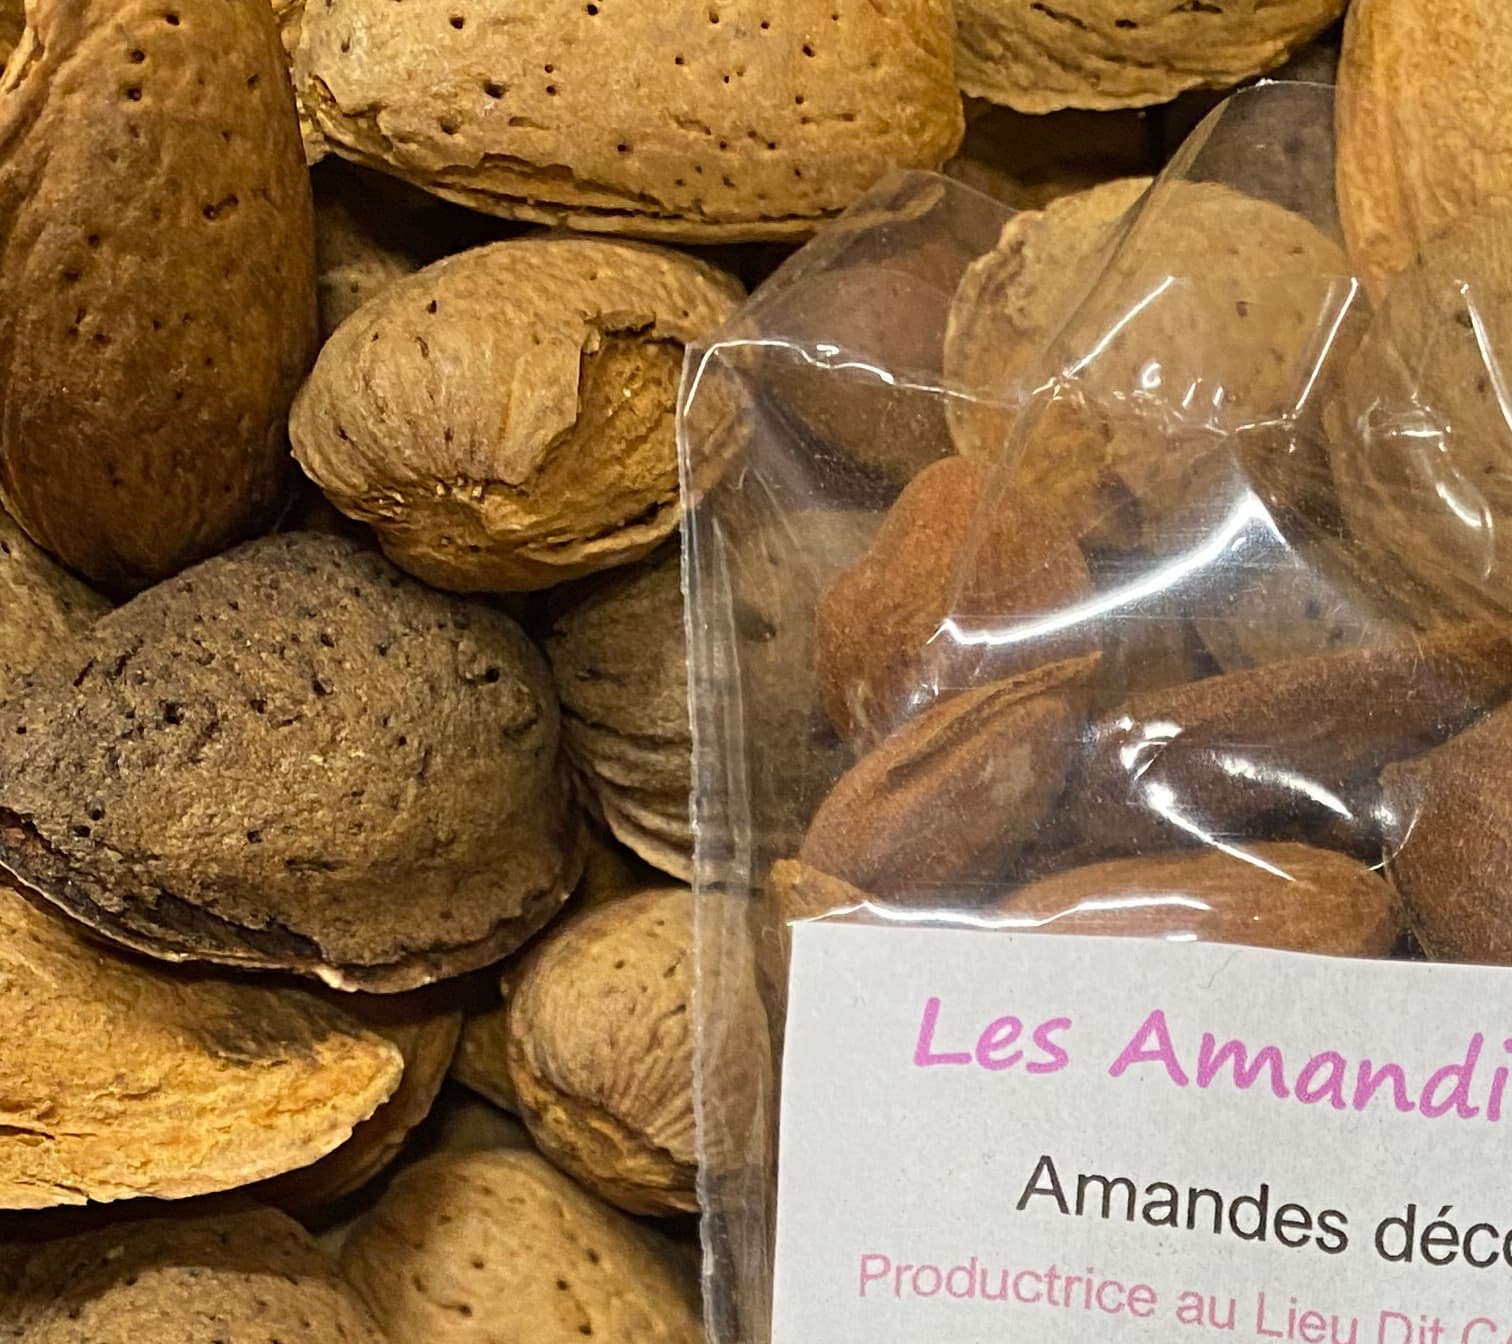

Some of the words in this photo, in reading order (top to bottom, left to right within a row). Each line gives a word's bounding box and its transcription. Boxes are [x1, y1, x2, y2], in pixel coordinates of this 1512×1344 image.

[914, 997, 1072, 1073] Les
[1016, 1155, 1349, 1254] Amandes
[861, 1254, 1156, 1317] Productrice
[1176, 1292, 1235, 1329] au
